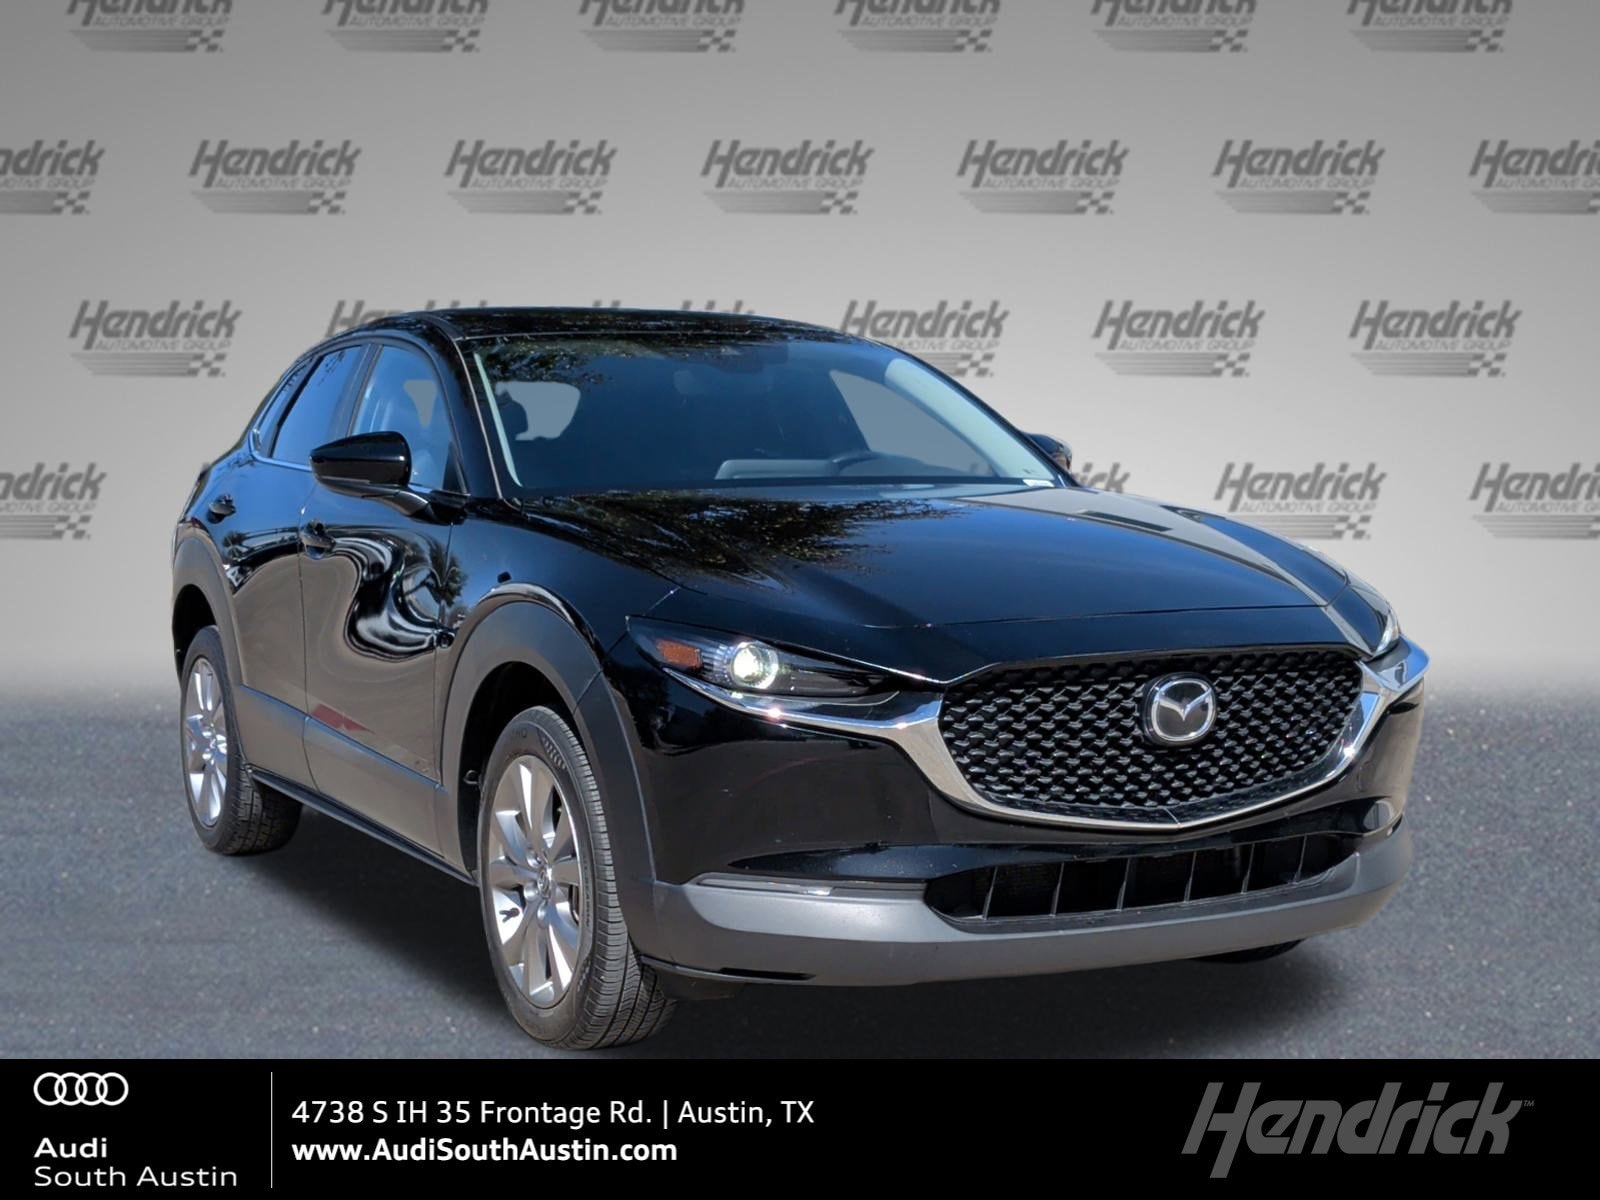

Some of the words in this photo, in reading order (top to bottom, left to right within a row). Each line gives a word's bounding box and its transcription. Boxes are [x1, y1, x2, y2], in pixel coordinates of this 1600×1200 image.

[189, 140, 361, 188] Hendrick
[444, 140, 617, 188] Hendrick
[701, 140, 874, 188] Hendrick
[957, 140, 1129, 188] Hendrick
[1213, 140, 1385, 188] Hendrick
[1469, 140, 1600, 188] Hendri
[69, 300, 242, 350] Hendrick
[840, 300, 1010, 337] Hendrick
[1092, 300, 1265, 350] Hendrick
[1349, 300, 1522, 350] Hendrick
[1214, 462, 1387, 512] Hendrick
[1469, 462, 1600, 512] Hendri
